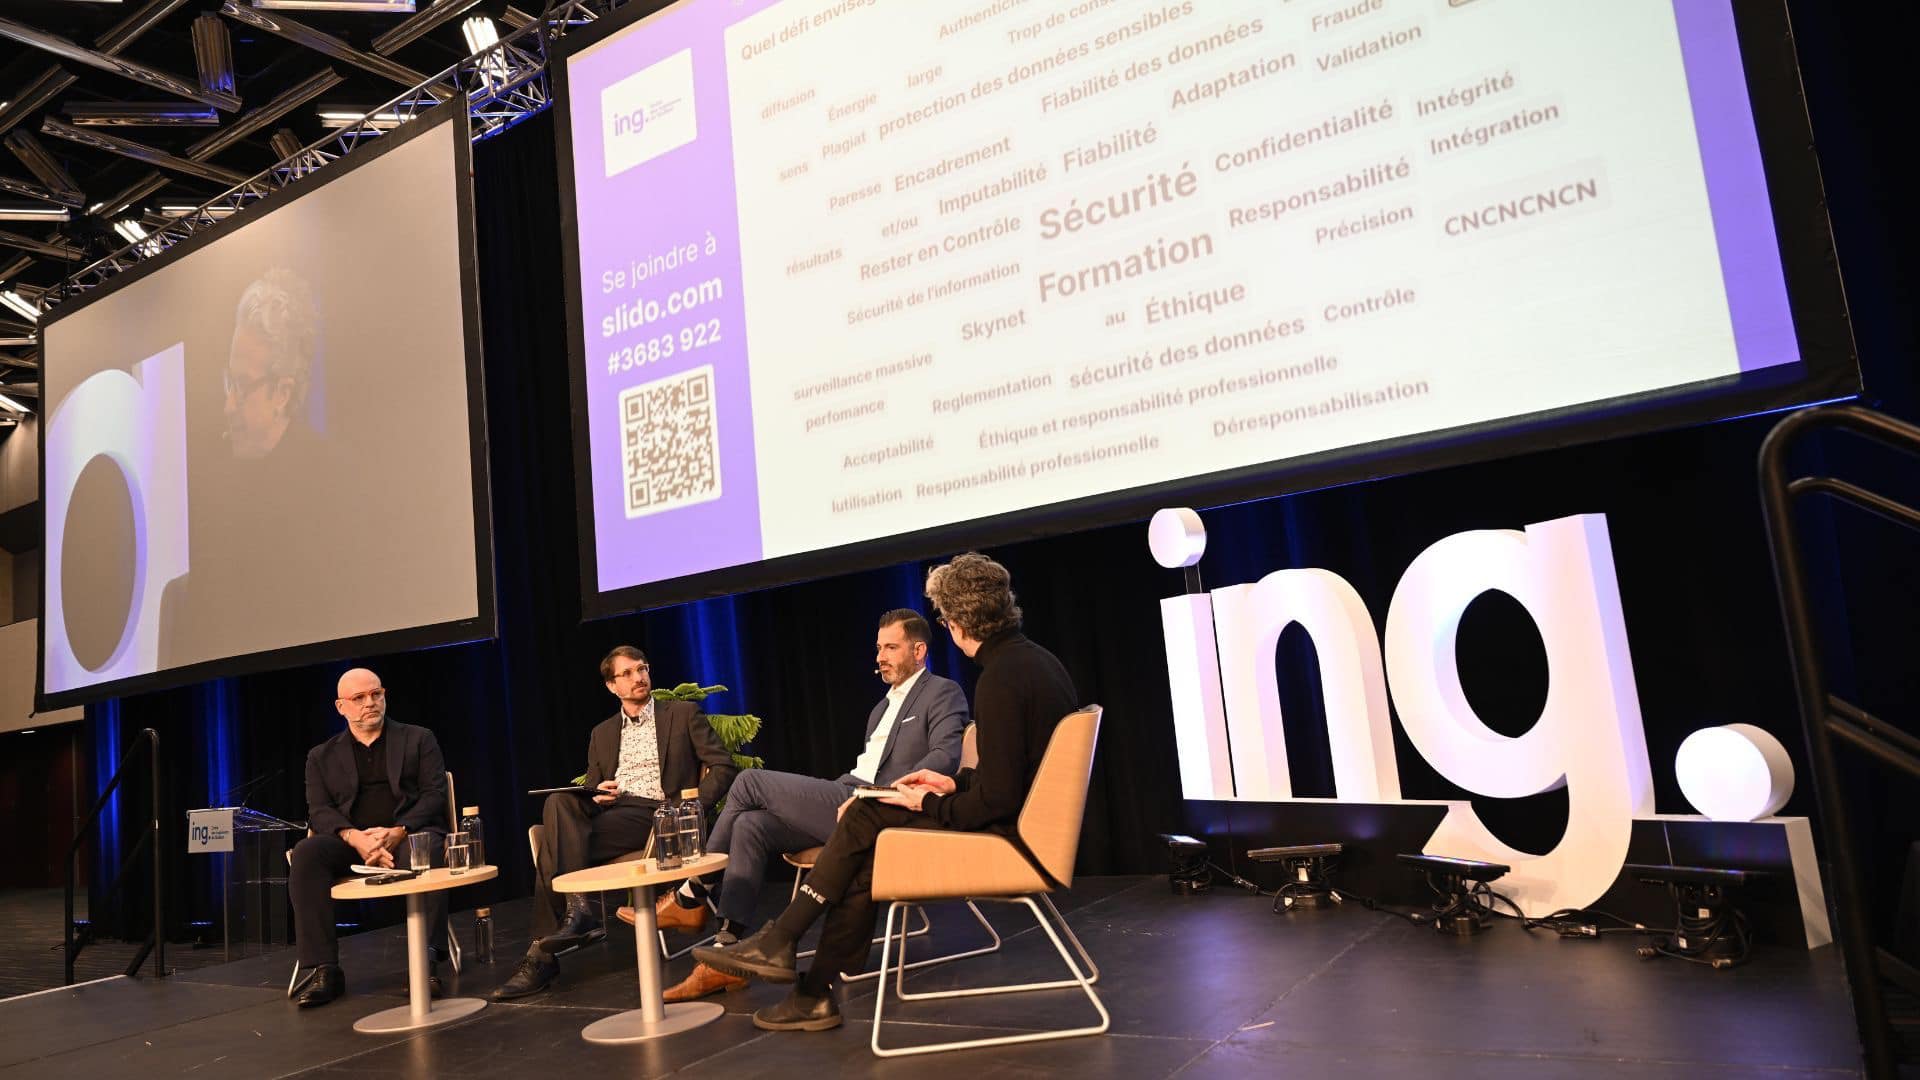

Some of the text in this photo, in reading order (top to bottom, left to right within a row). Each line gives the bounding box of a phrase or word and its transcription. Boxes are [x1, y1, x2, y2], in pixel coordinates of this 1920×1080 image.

[741, 32, 776, 61] Quel
[780, 15, 809, 44] défi
[1008, 22, 1042, 46] Trop
[1046, 12, 1066, 29] de
[1312, 0, 1383, 32] Fraude
[877, 1, 1194, 142] protection des données sensibles
[1041, 17, 1265, 113] Fiabilité des données
[1316, 25, 1423, 72] Validation
[907, 65, 943, 88] large
[1171, 51, 1296, 110] Adaptation
[1416, 71, 1515, 117] Intégrité
[613, 108, 649, 137] ing.
[761, 88, 816, 120] diffusion
[821, 130, 867, 160] Plagiat
[1062, 121, 1159, 173] Fiabilité
[1215, 98, 1395, 173] Confidentialité
[1430, 102, 1560, 157] Intégration
[780, 160, 809, 182] sens
[894, 136, 1011, 192] Encadrement
[828, 181, 882, 211] Paresse
[938, 162, 1048, 217] Imputabilité
[1039, 160, 1200, 241] Sécurité
[1228, 157, 1412, 229] Responsabilité
[1444, 178, 1599, 238] CNCNCNCN
[859, 214, 1022, 281] Rester en Contrôle
[881, 215, 920, 240] et/ou
[1315, 205, 1415, 246] Précision
[602, 230, 718, 294] Se joindre à
[786, 246, 844, 277] résultats
[1038, 229, 1215, 304] Formation
[601, 275, 724, 338] slido.com
[847, 296, 905, 326] Sécurité
[907, 289, 924, 306] de
[961, 308, 1027, 342] Skynet
[1105, 311, 1127, 328] au
[1146, 280, 1246, 326] Éthique
[1322, 286, 1416, 323] Contrôle
[607, 318, 722, 376] #3683 922
[1069, 314, 1306, 390] sécurité des données
[793, 352, 933, 401] surveillance massive
[805, 399, 885, 433] perfomance
[978, 352, 1339, 450] Éthique et responsabilité professionnelle
[1212, 378, 1431, 438] Déresponsabilisation
[842, 434, 935, 470] Acceptabilité
[915, 433, 1160, 498] Responsabilité professionnelle
[1148, 508, 1796, 919] ing.
[191, 821, 212, 845] ing.
